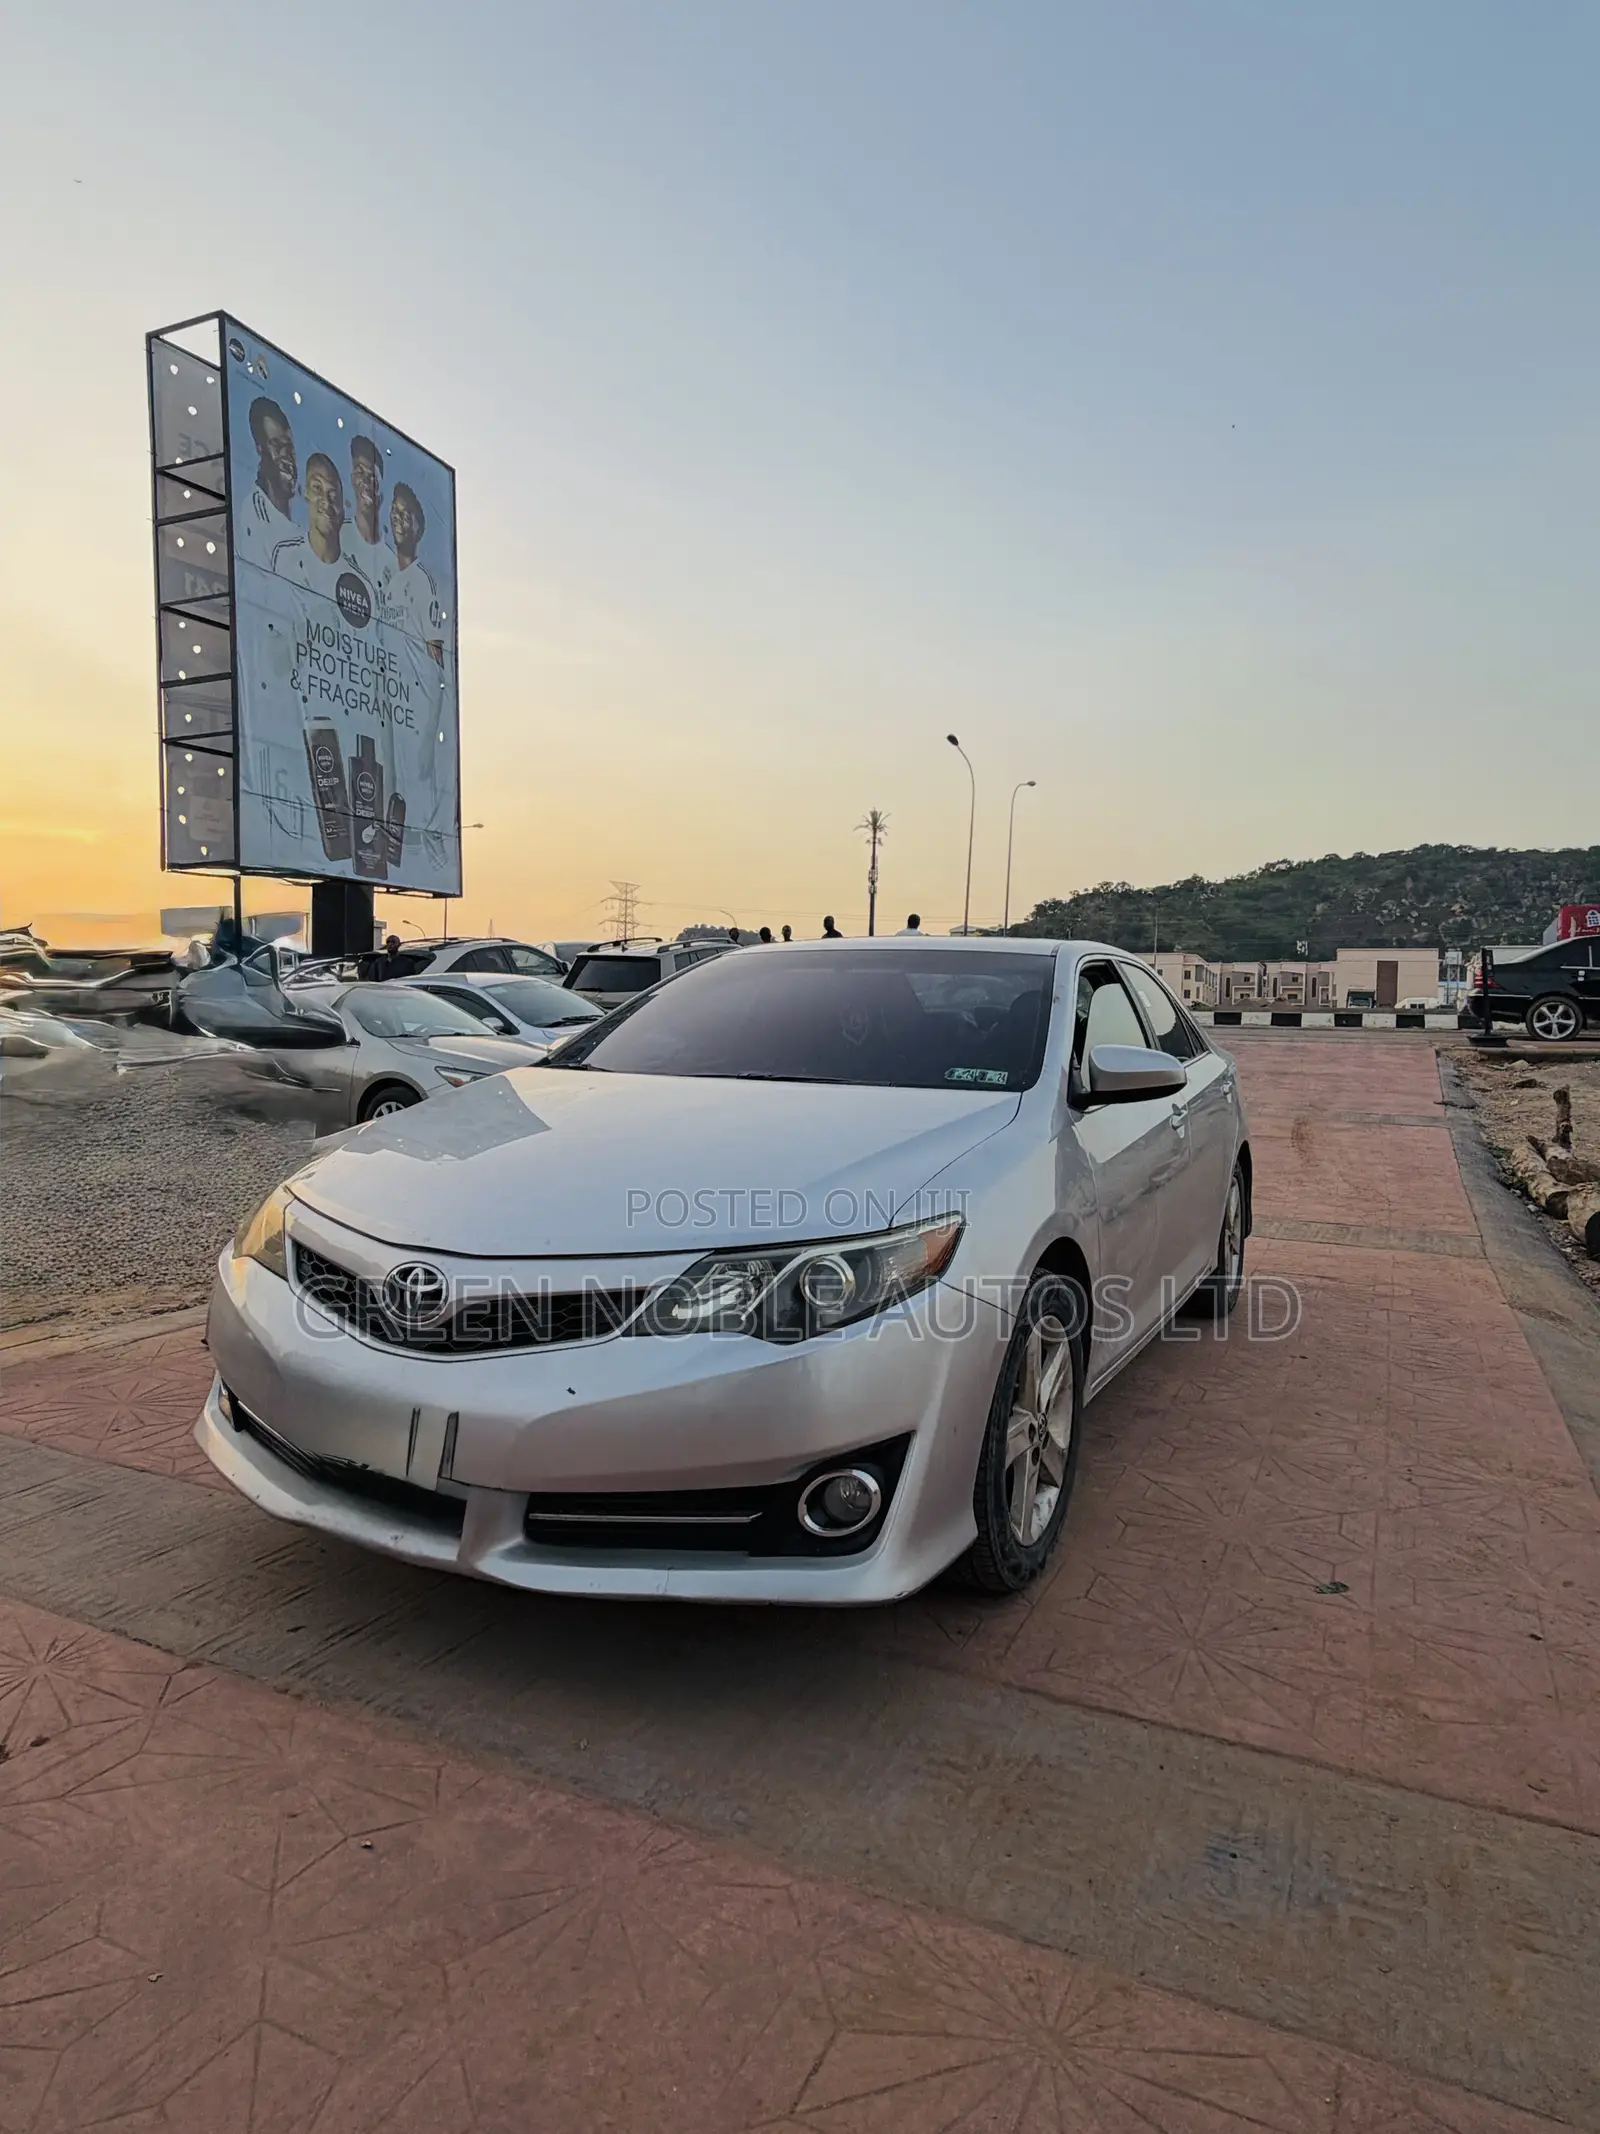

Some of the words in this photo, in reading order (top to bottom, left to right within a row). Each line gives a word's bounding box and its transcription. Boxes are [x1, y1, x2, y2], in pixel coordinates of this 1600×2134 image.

[340, 586, 369, 609] NIVEA
[343, 600, 366, 618] MEN
[306, 618, 402, 678] MOISTURE,
[290, 668, 303, 691] &
[296, 641, 410, 703] PROTECTION
